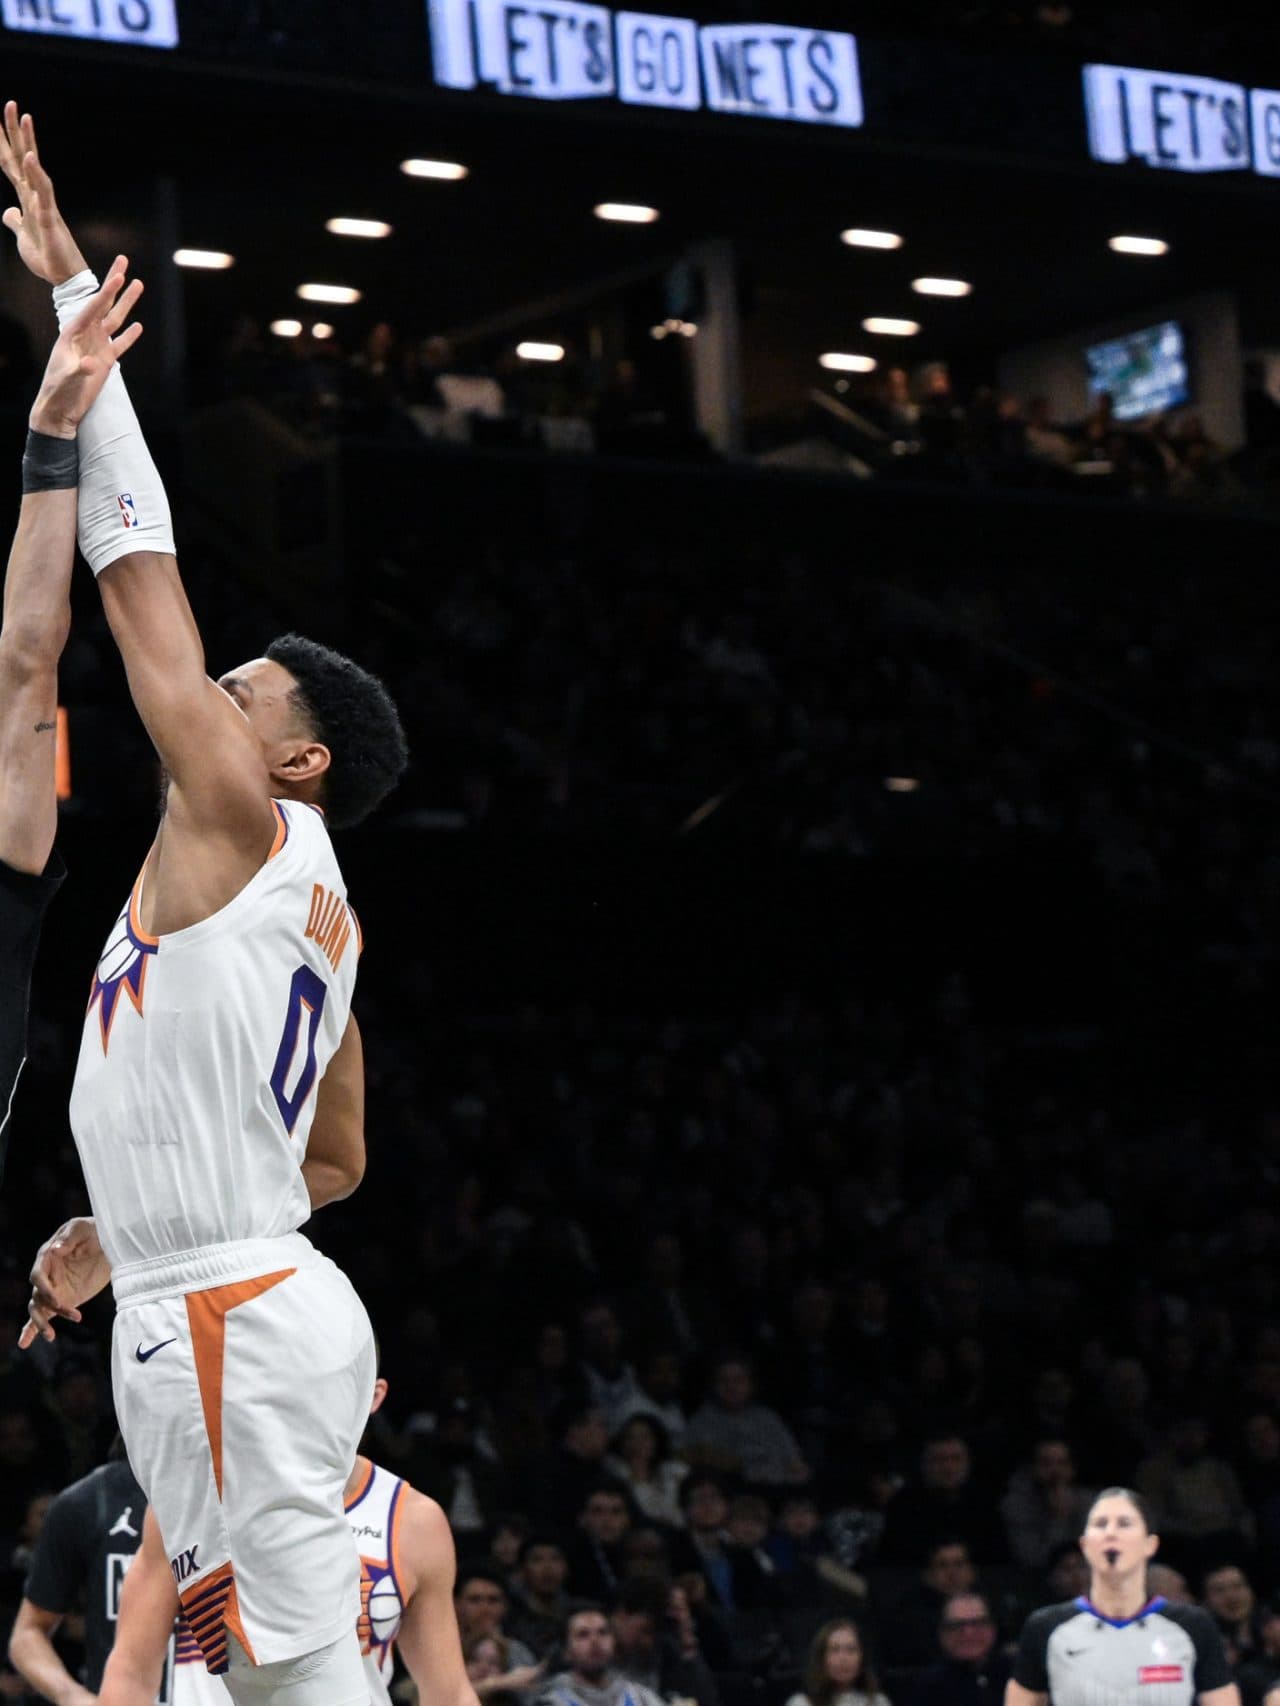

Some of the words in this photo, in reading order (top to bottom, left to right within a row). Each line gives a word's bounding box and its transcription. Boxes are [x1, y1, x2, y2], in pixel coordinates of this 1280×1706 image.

[468, 0, 607, 88] LET'S
[632, 27, 685, 95] GO
[713, 35, 840, 114] NETS
[1117, 78, 1240, 160] LET'S
[270, 963, 328, 1140] 0
